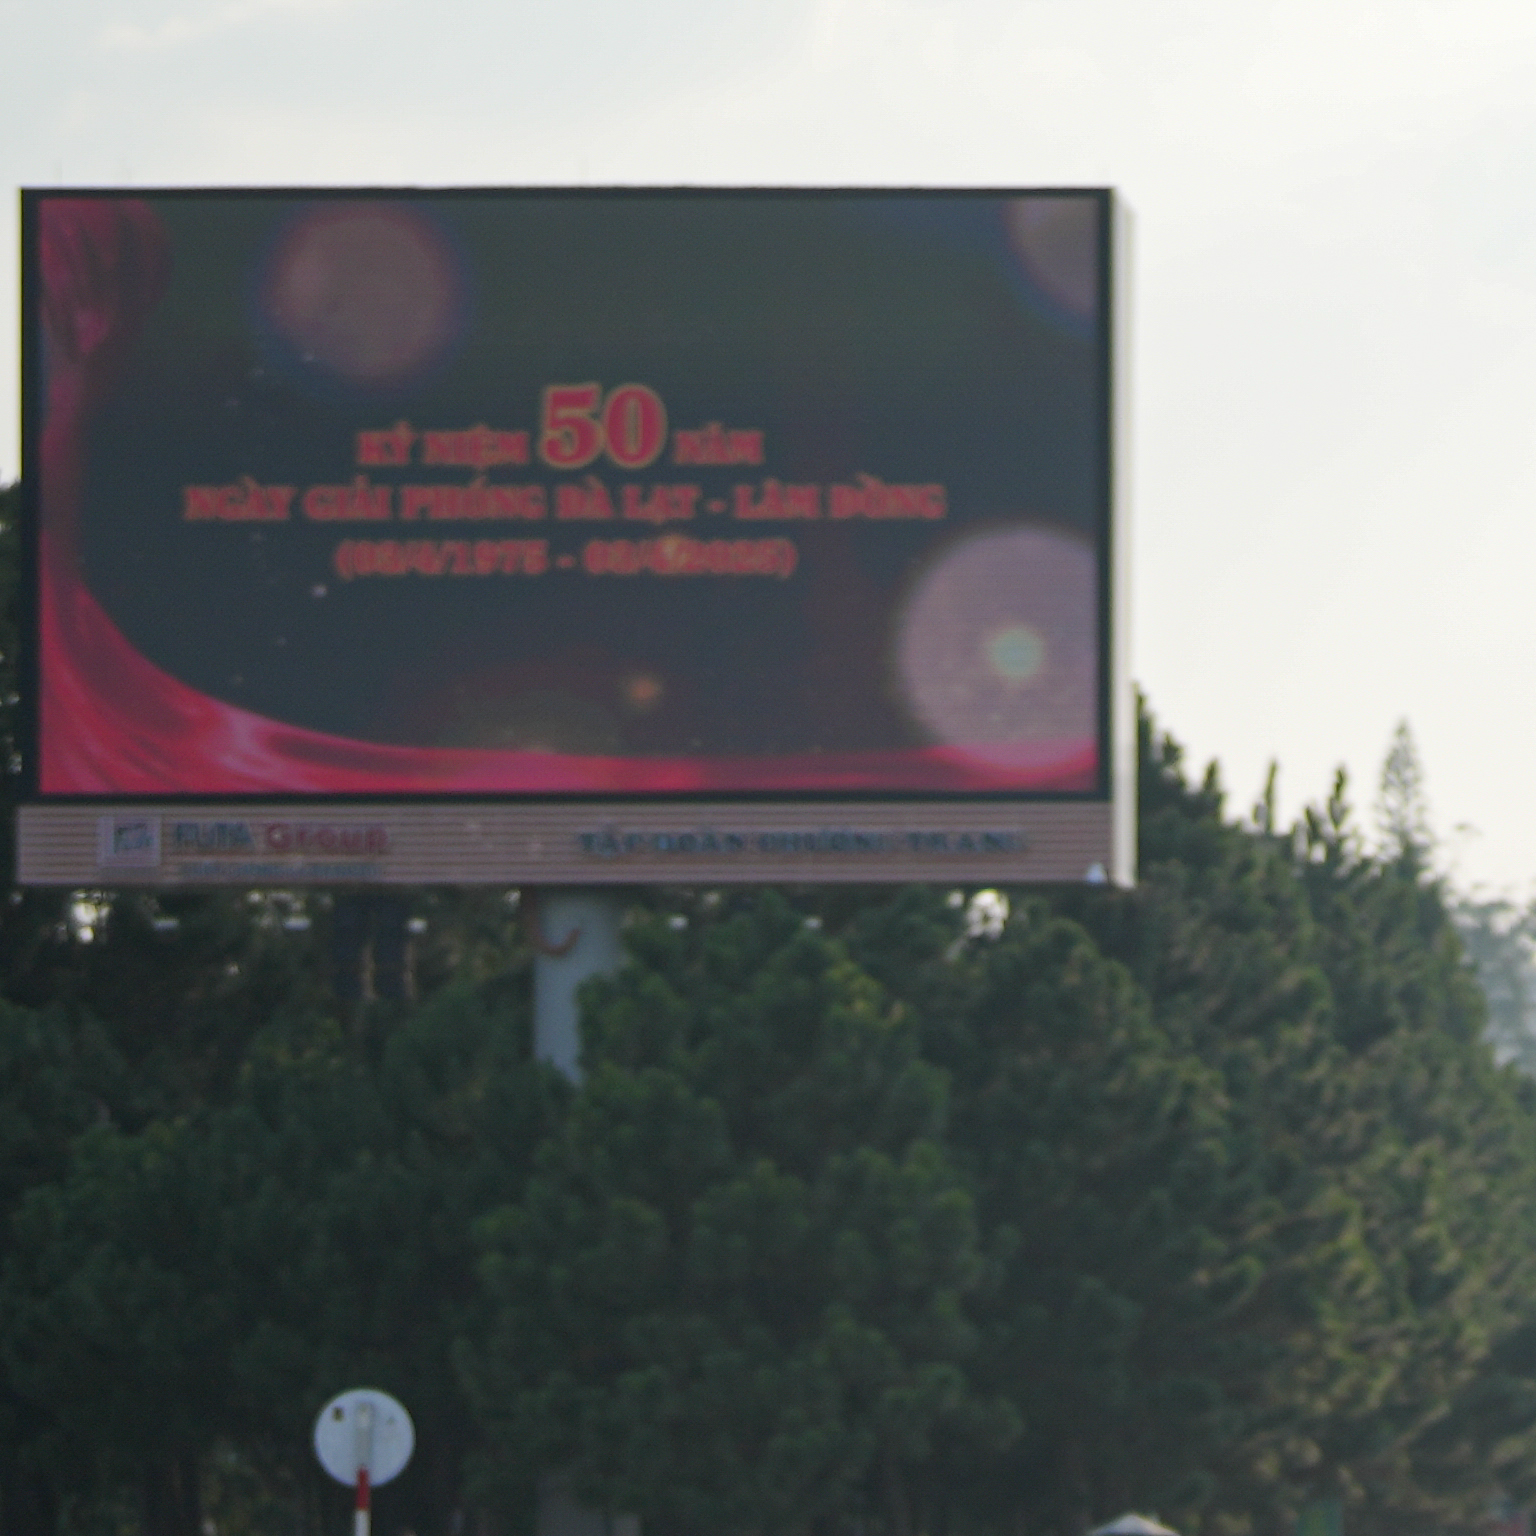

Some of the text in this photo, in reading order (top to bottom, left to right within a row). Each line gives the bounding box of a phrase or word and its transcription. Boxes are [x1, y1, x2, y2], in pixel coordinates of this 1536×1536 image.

[539, 382, 668, 468] 50
[184, 475, 296, 520] NGÀY
[402, 475, 547, 520] PHÓNG
